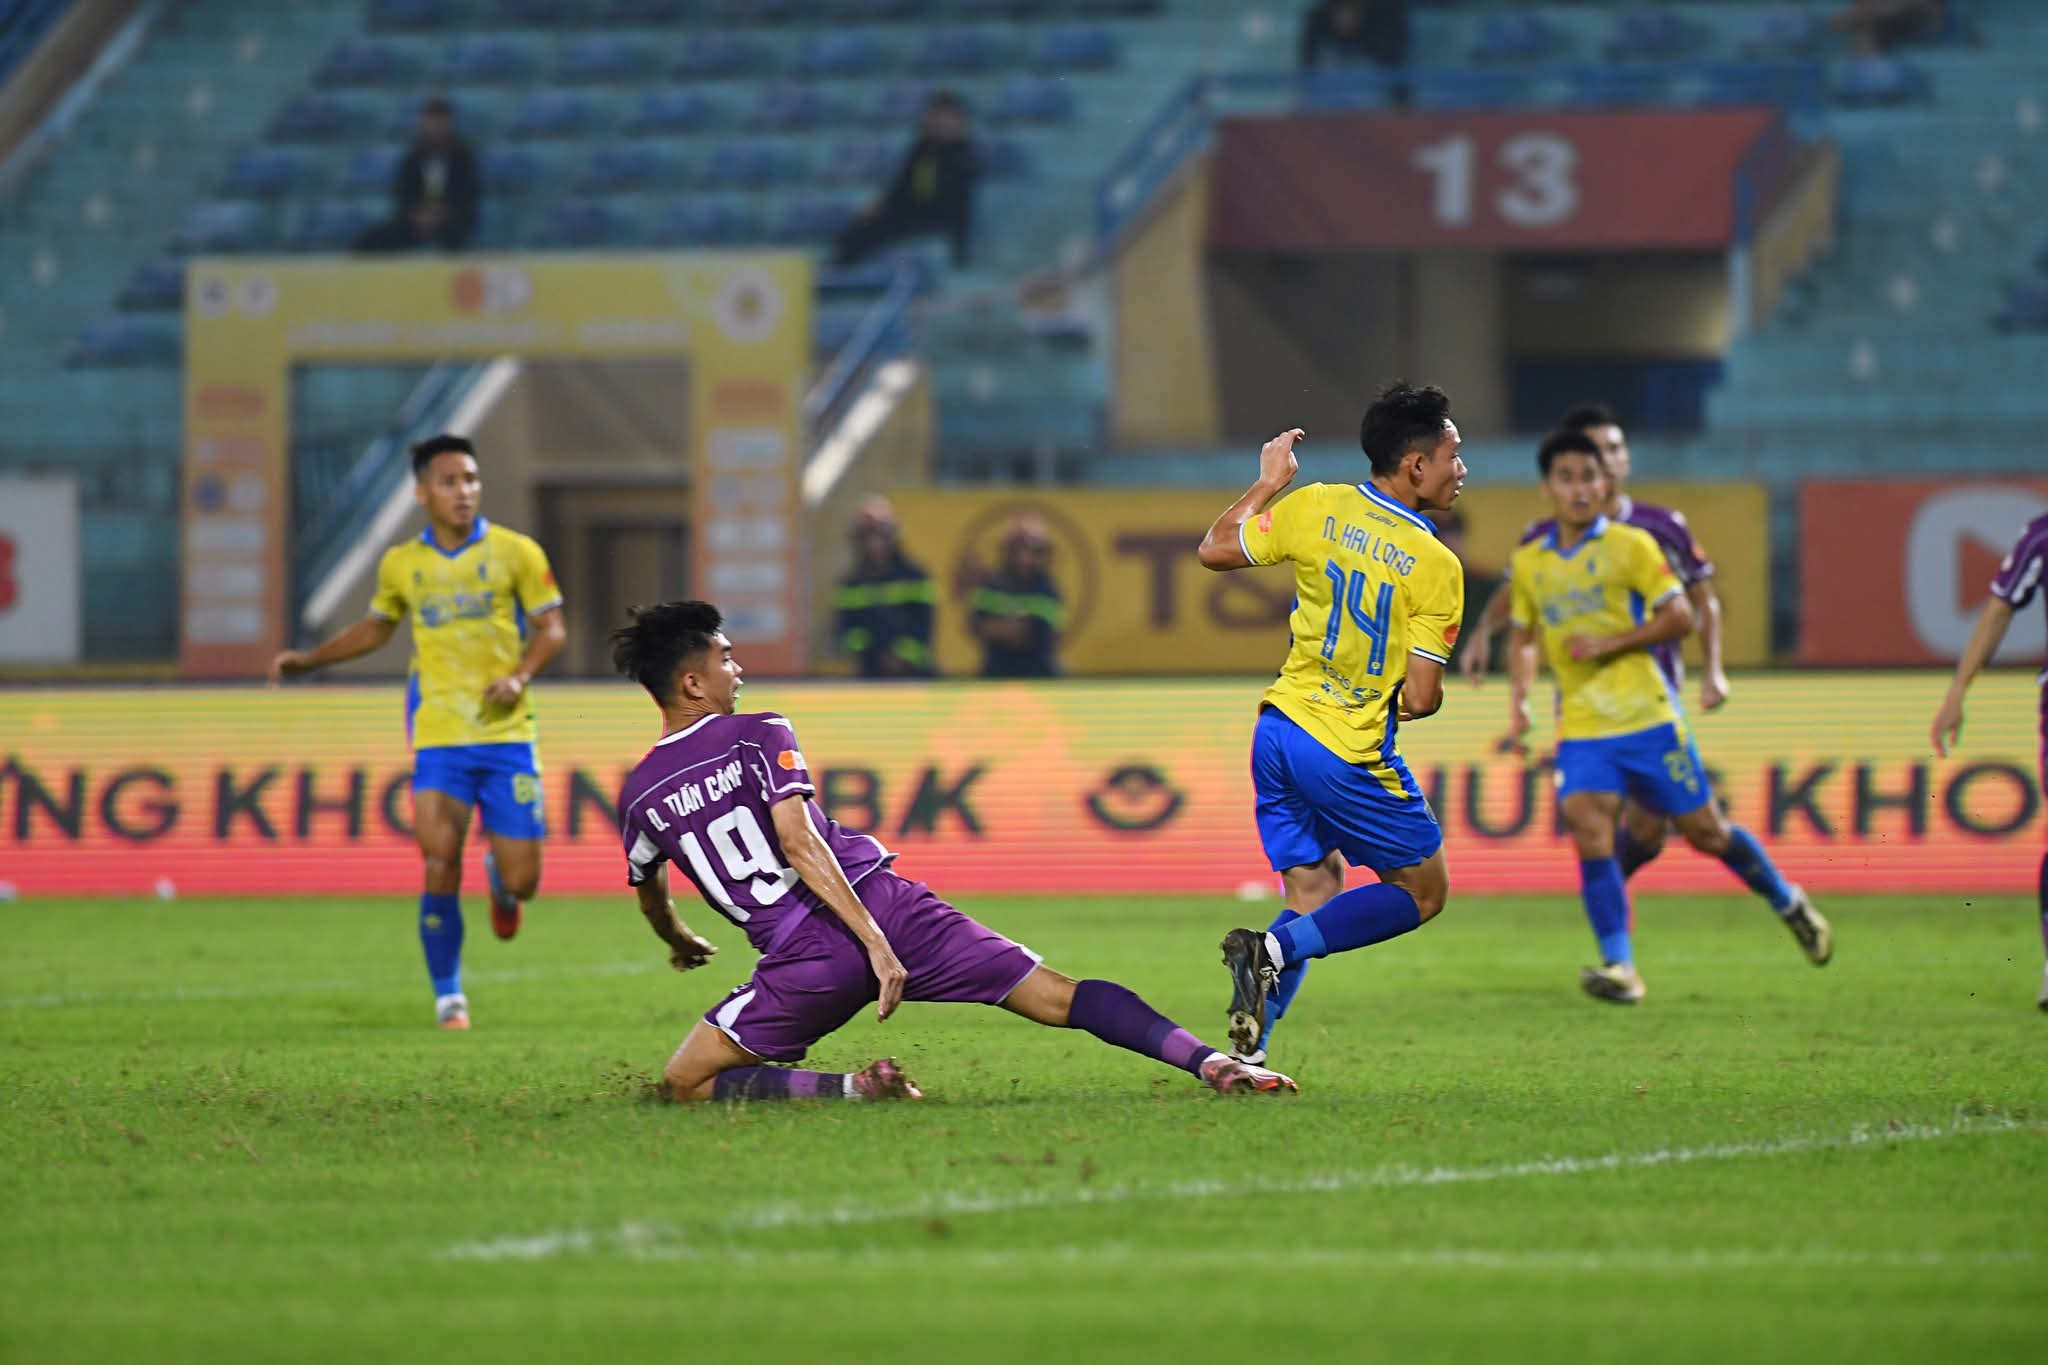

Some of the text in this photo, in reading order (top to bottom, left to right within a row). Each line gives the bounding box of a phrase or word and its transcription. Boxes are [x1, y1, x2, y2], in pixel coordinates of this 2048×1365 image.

[1411, 135, 1580, 227] 13
[1320, 559, 1395, 676] 14
[0, 754, 181, 844] NG
[678, 805, 800, 923] 19
